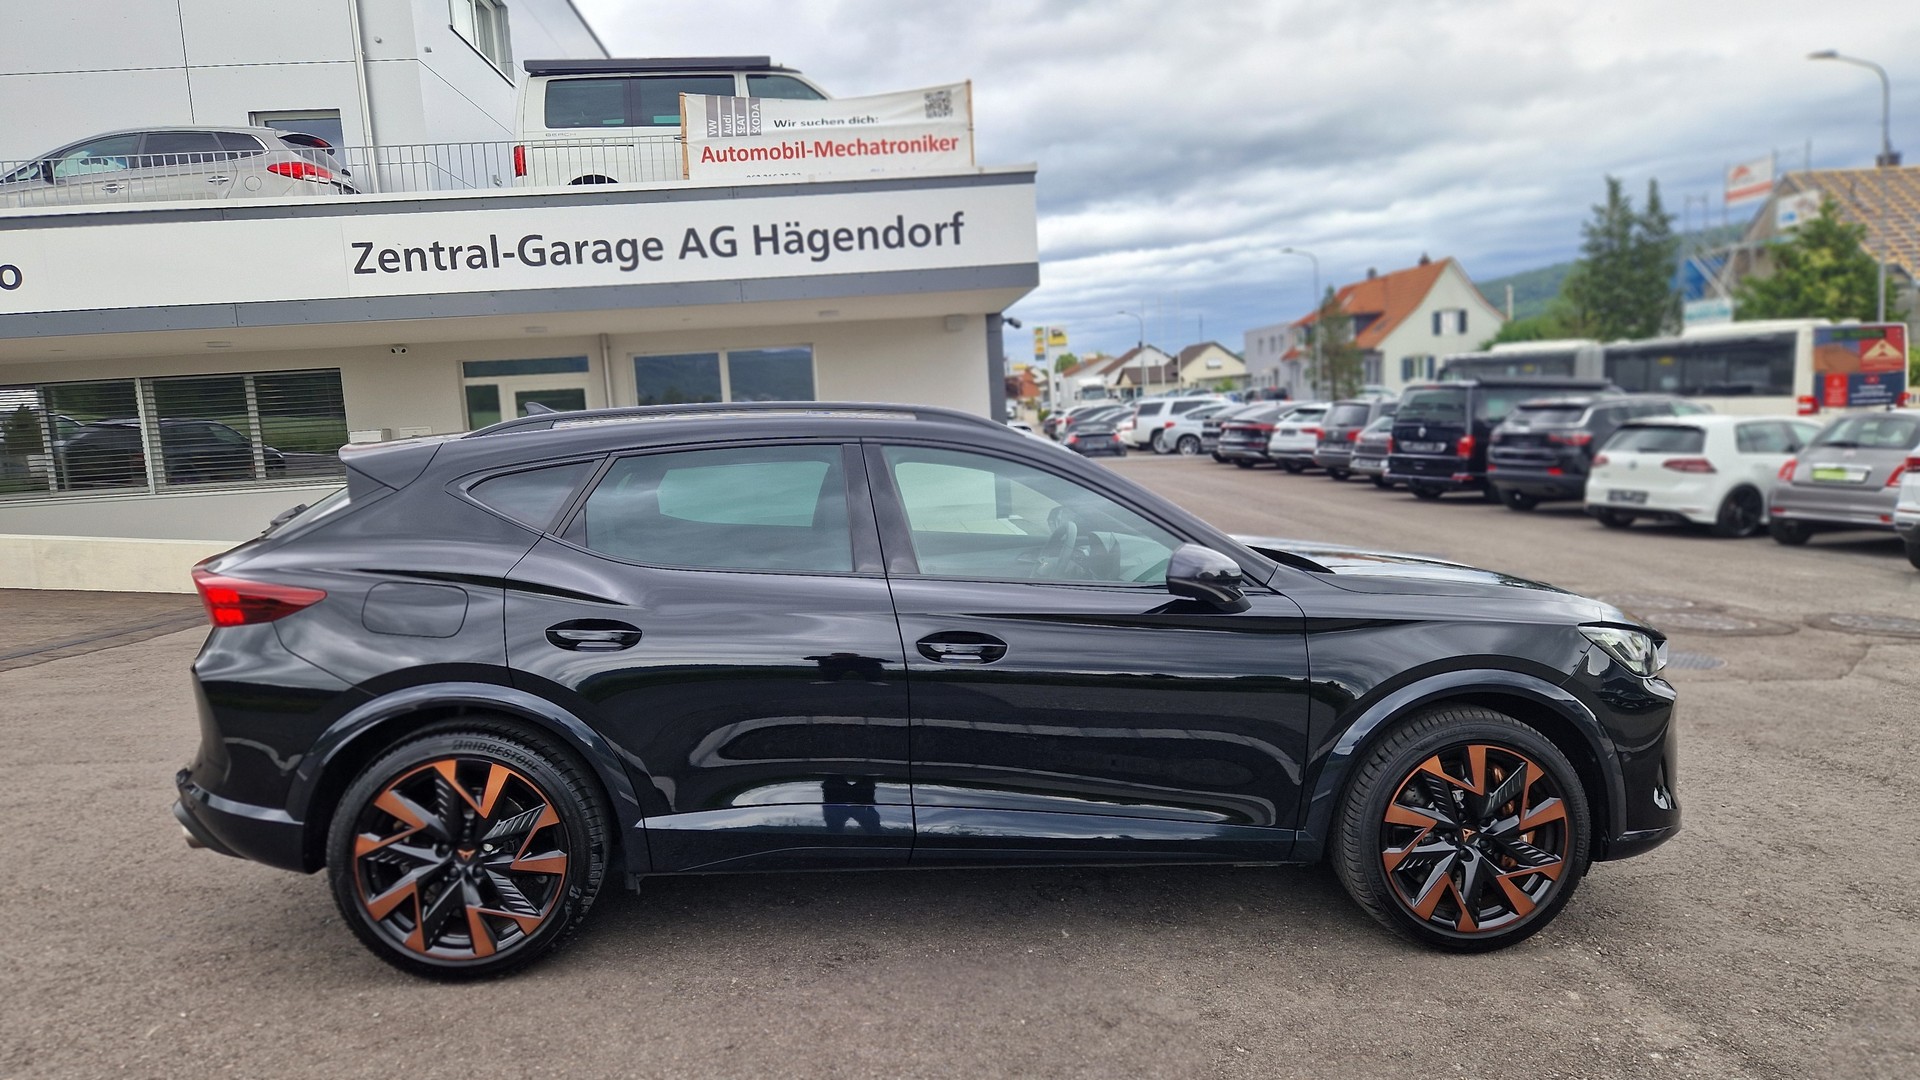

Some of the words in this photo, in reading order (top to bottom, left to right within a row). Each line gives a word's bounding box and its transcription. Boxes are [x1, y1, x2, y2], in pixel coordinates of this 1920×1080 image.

[708, 119, 718, 136] VW
[722, 114, 732, 135] Audi
[736, 113, 746, 134] SEAT
[773, 119, 797, 128] Wir
[800, 117, 845, 127] suchen
[848, 115, 879, 125] dich:
[701, 134, 959, 164] Automobil-Mechatroniker
[351, 234, 664, 274] Zentral-Garage
[678, 225, 738, 260] AG
[753, 211, 965, 263] Hägendorf
